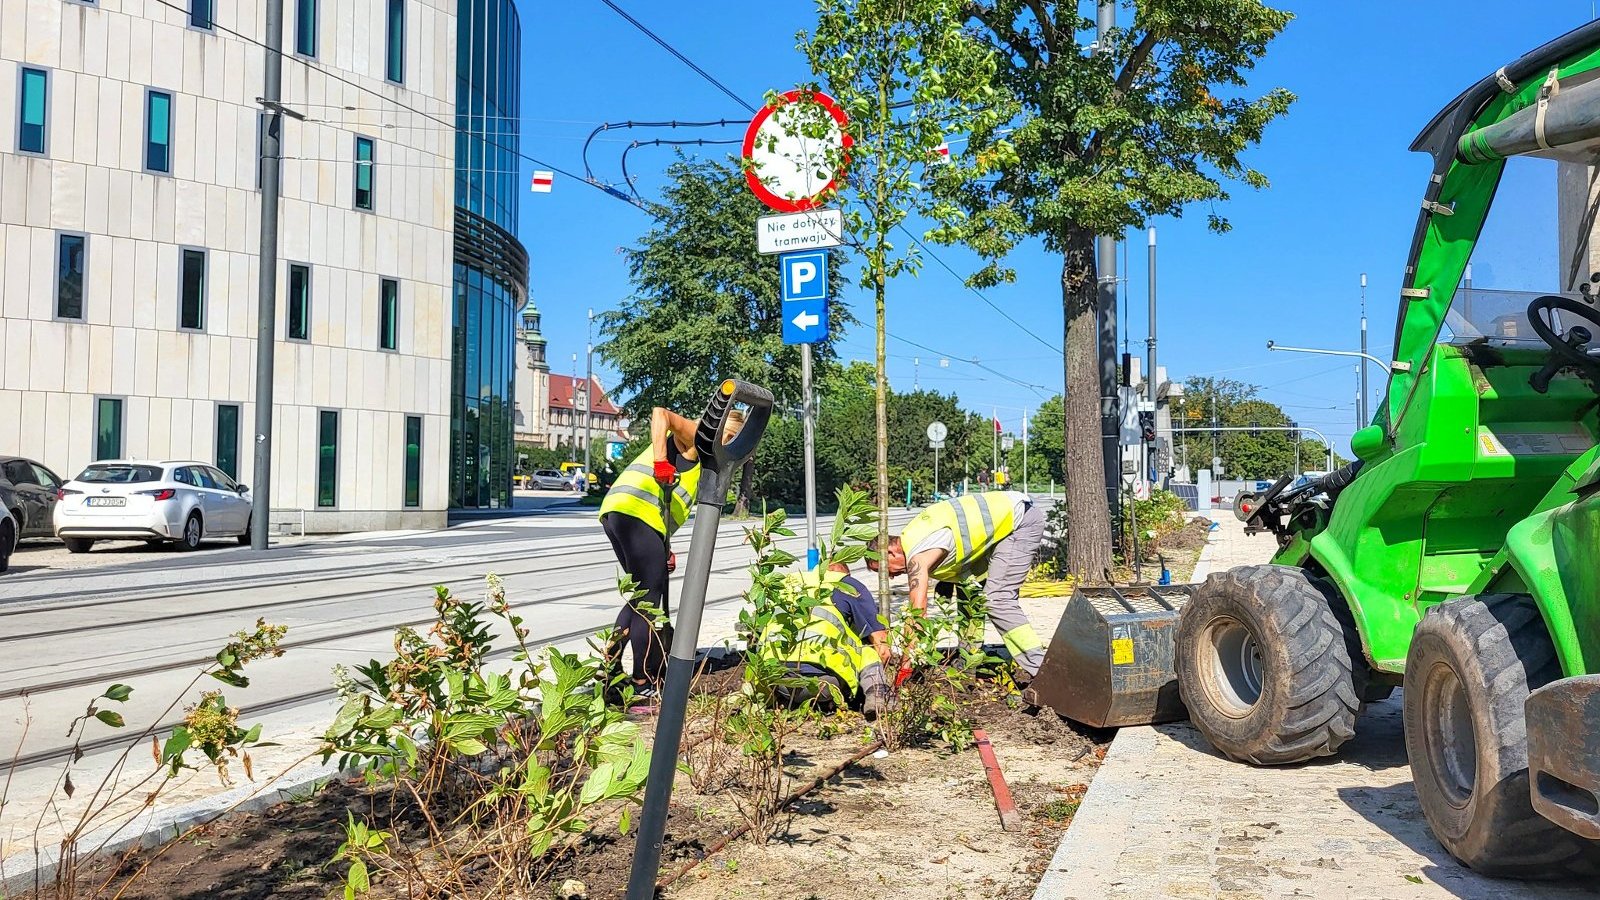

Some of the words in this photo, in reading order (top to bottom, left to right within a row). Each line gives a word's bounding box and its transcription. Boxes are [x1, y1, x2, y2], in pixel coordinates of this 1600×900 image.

[767, 222, 786, 233] Nie
[793, 217, 835, 230] dotyczy
[774, 231, 827, 246] tramwaju
[791, 261, 817, 295] P
